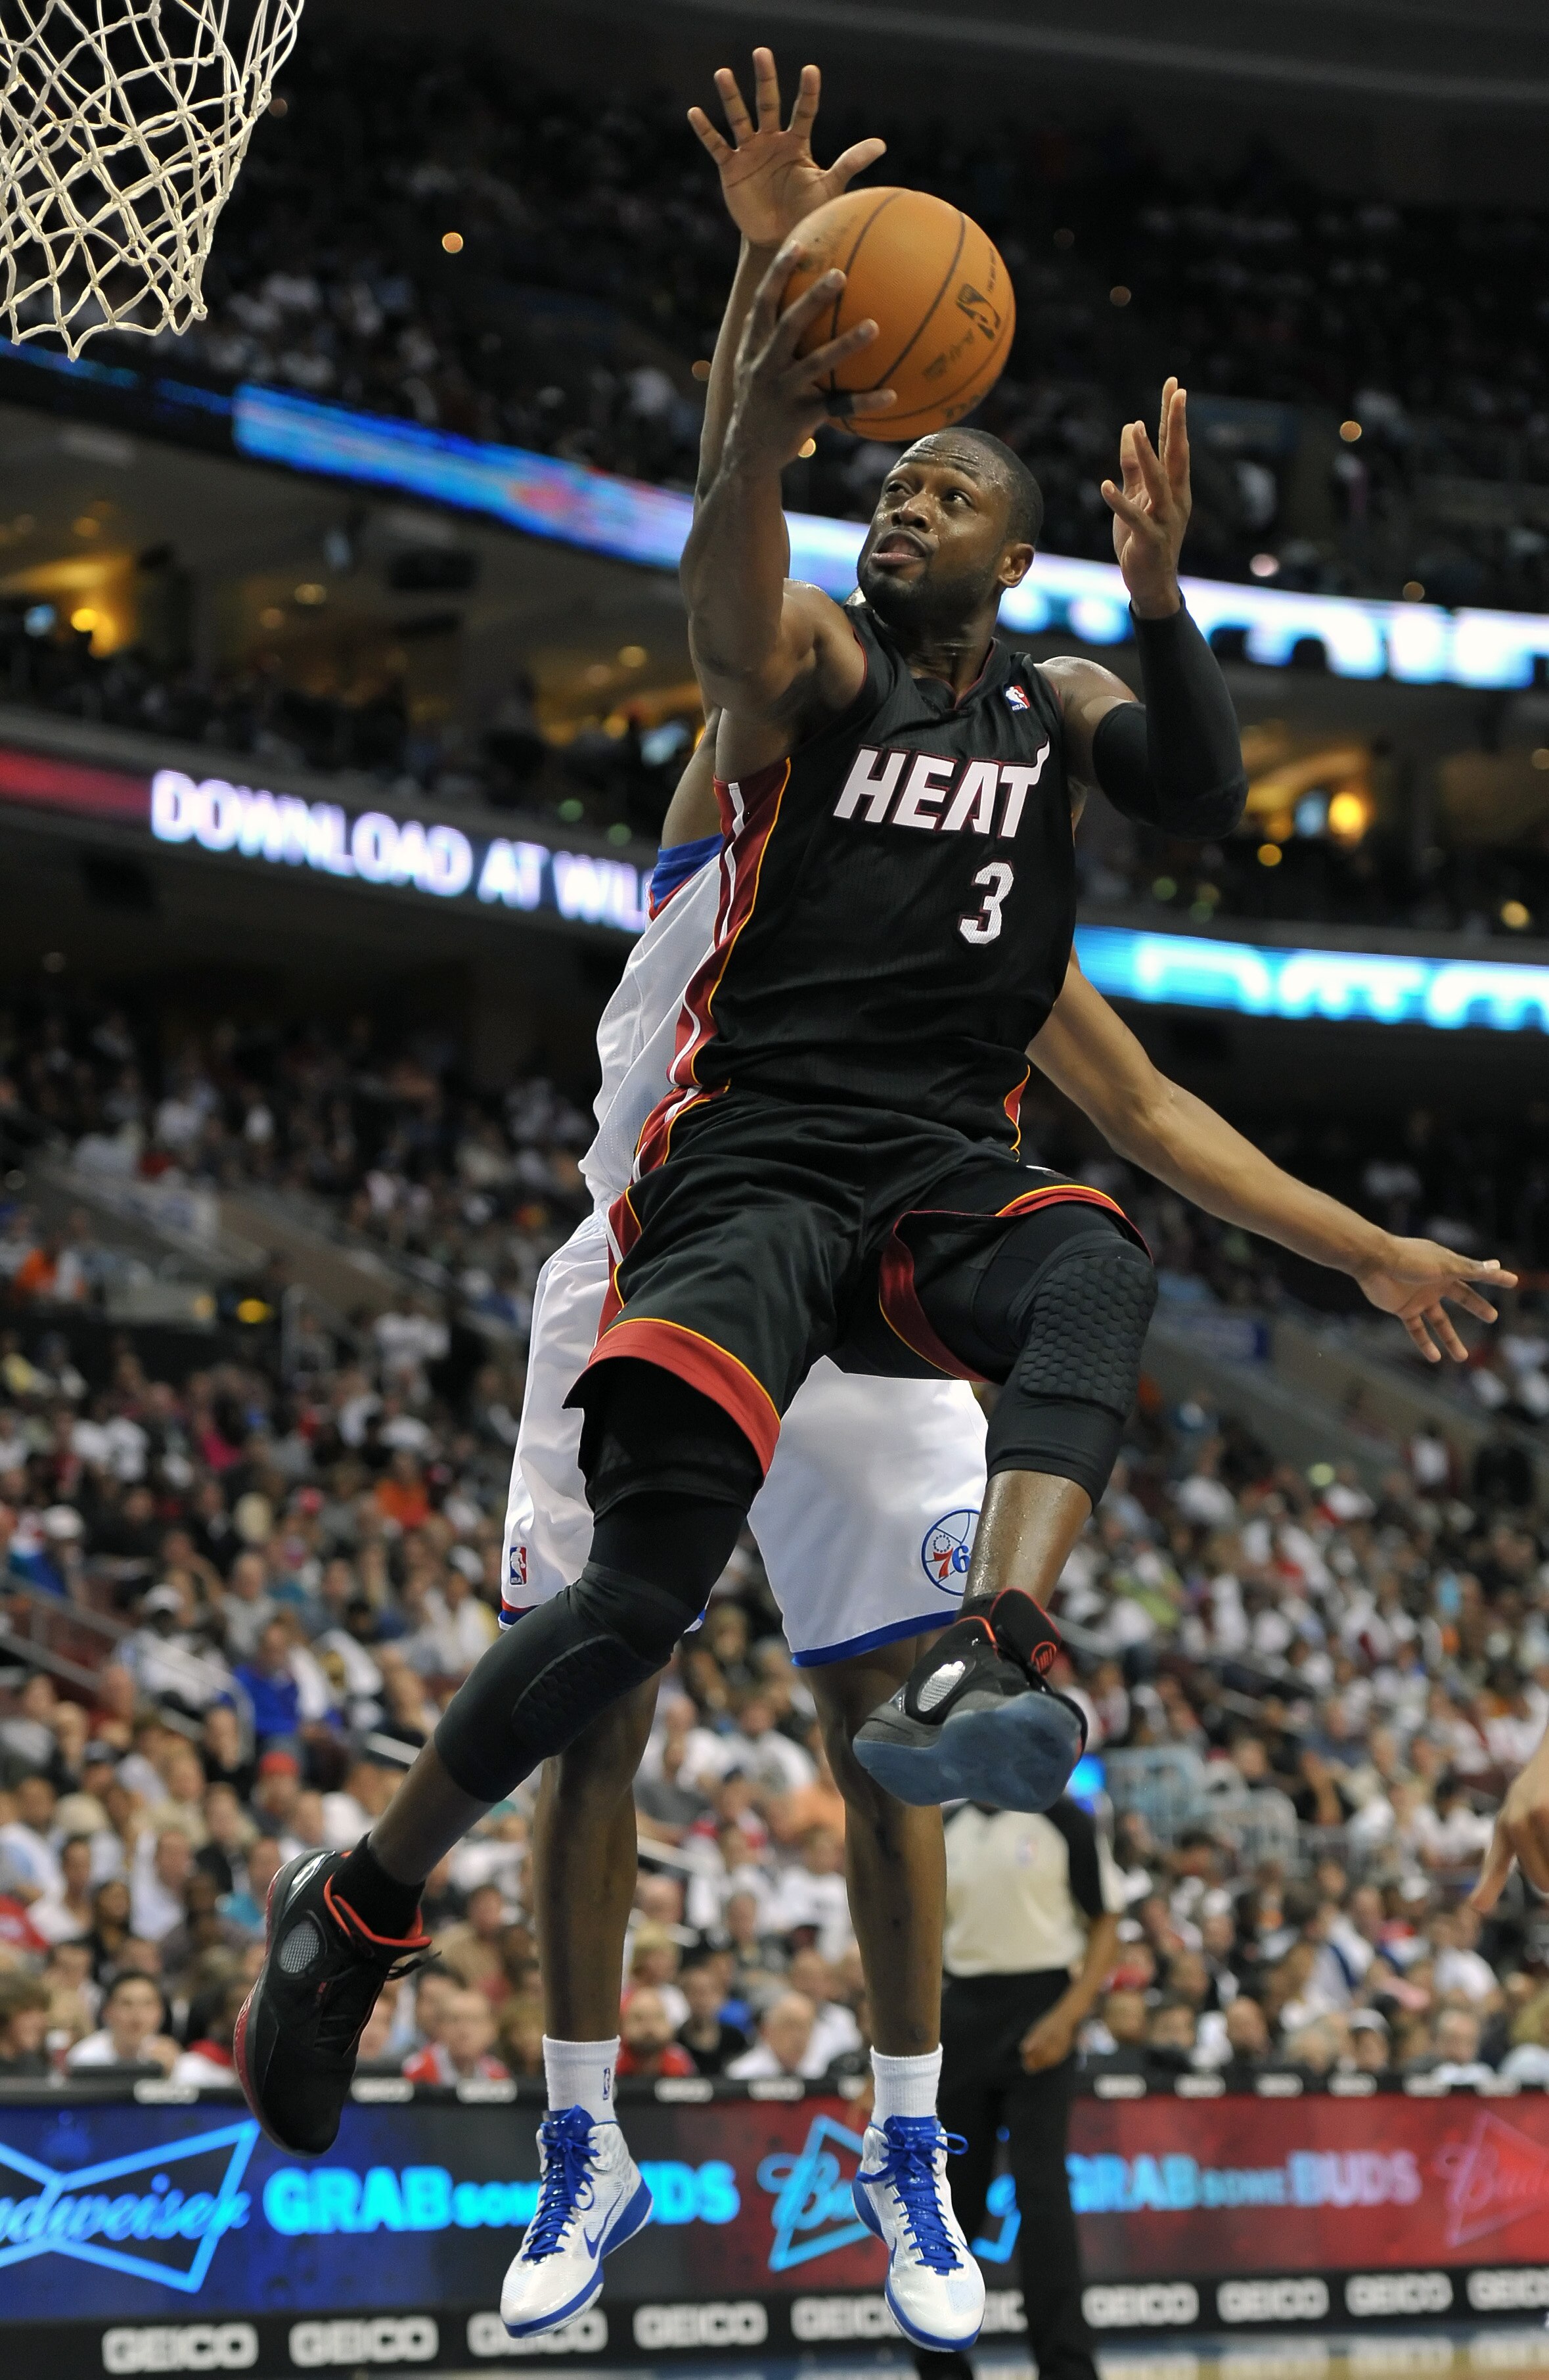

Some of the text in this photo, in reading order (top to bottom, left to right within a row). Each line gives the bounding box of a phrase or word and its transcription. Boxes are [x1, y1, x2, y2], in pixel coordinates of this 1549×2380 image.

[832, 738, 1050, 838] HEAT
[151, 769, 473, 897] DOWNLOAD
[477, 837, 550, 912] AT
[958, 860, 1015, 945] 3
[264, 2166, 453, 2234] GRAB
[1286, 2149, 1422, 2208] BUDS
[1081, 2282, 1200, 2328] GEICO
[1216, 2277, 1330, 2324] GEICO
[1344, 2271, 1454, 2317] GEICO
[102, 2322, 259, 2375] GEICO
[289, 2315, 439, 2367] GEICO
[632, 2301, 768, 2350] GEICO
